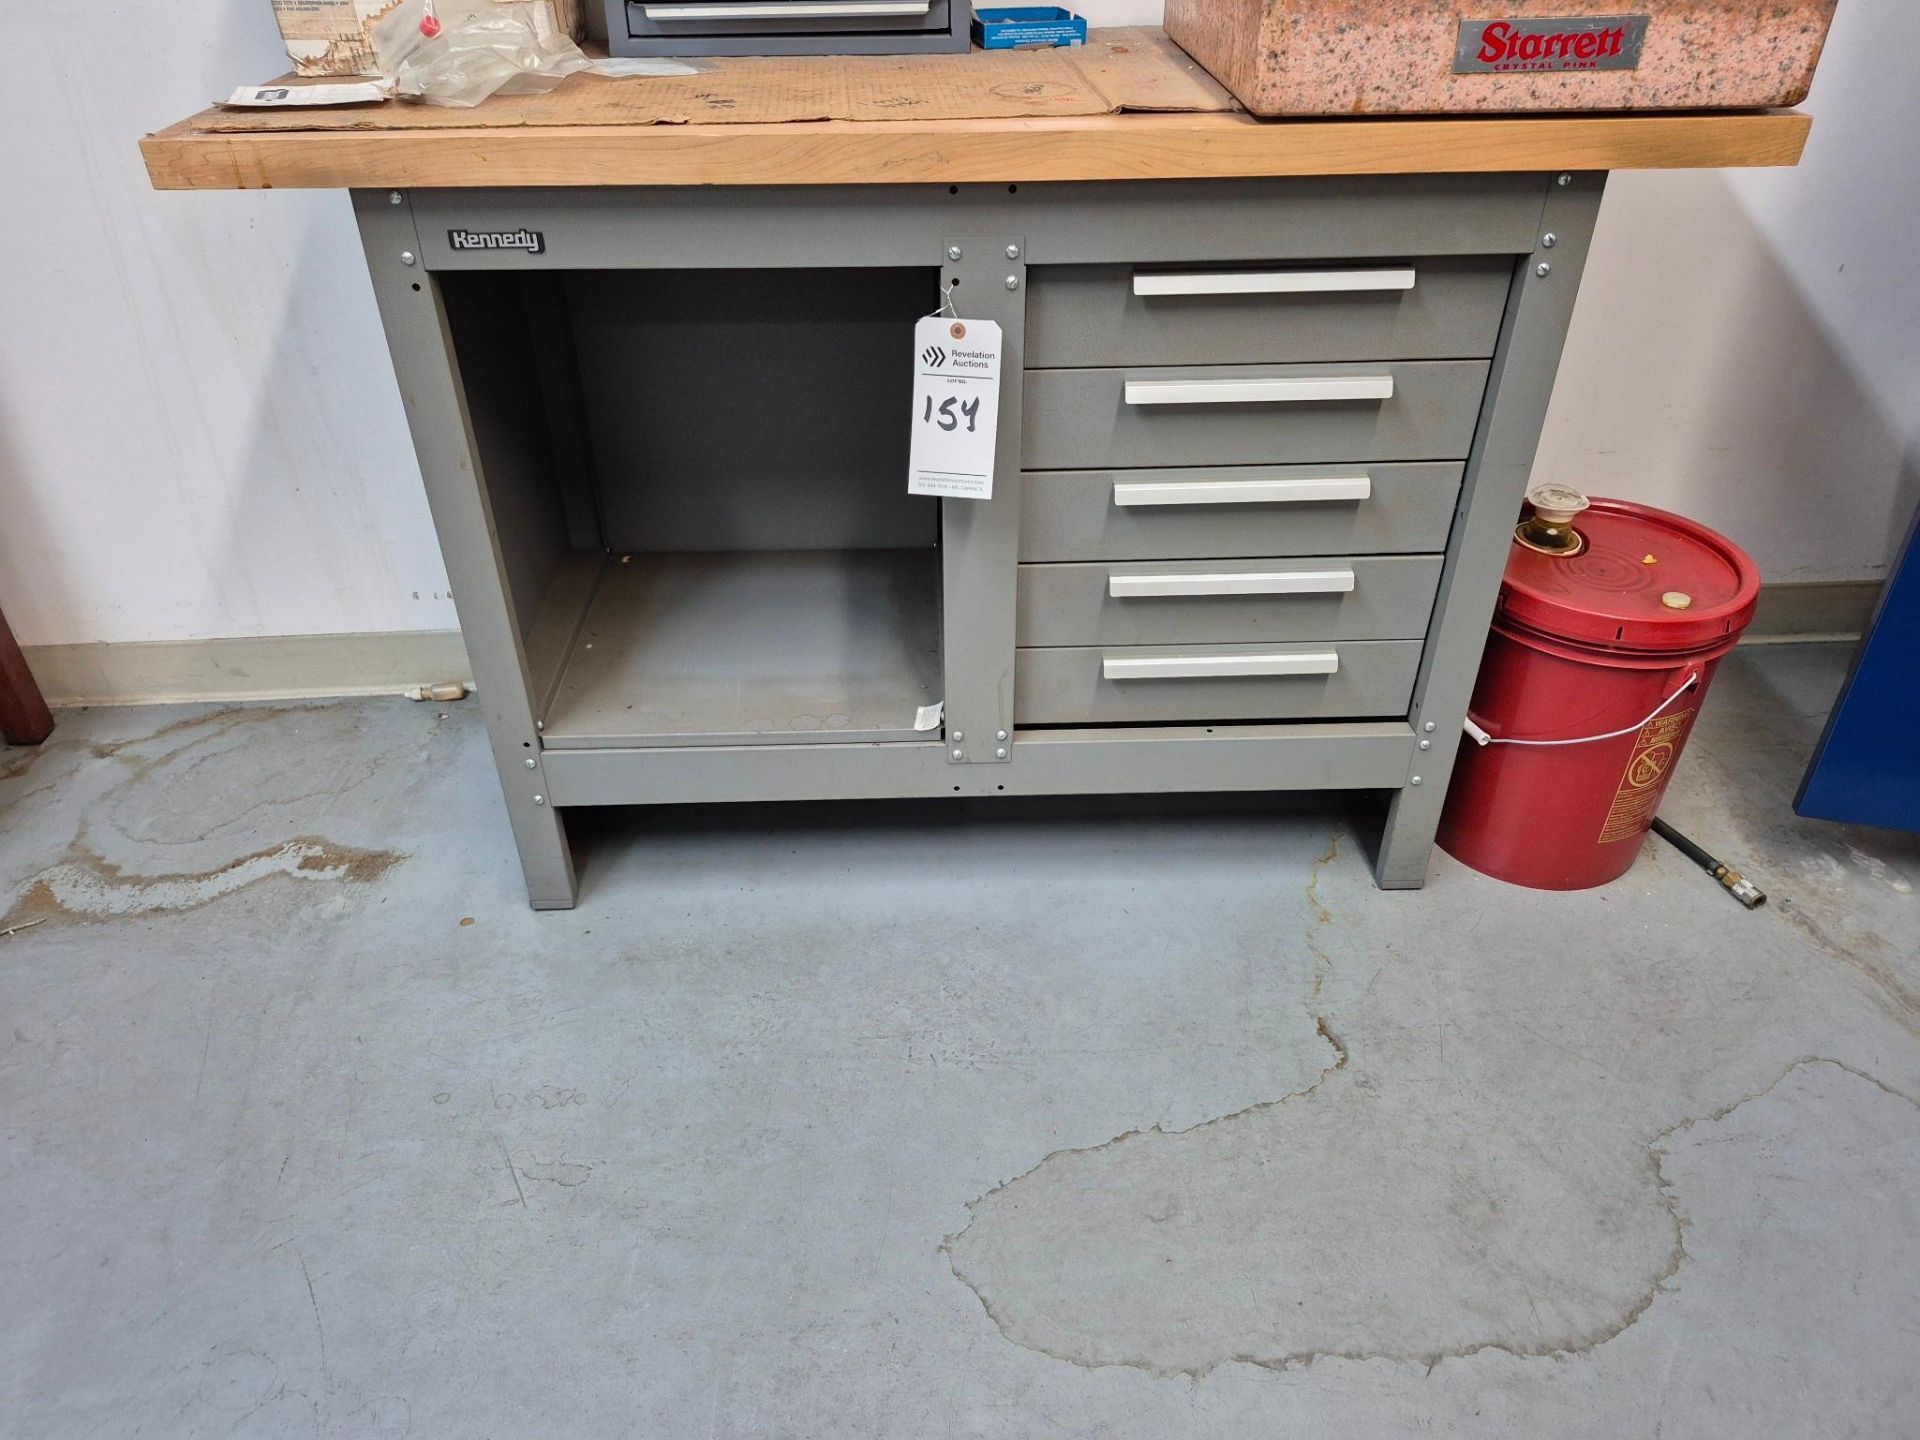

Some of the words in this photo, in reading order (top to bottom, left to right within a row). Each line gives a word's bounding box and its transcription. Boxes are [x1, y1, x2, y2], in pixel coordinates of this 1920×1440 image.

[1476, 21, 1625, 63] Starrett
[1494, 62, 1553, 71] CRYSTAL
[1563, 61, 1598, 69] PINK
[452, 228, 540, 252] Kennedy
[951, 349, 995, 360] Revelation
[952, 359, 989, 369] Auctions
[923, 394, 980, 433] 154
